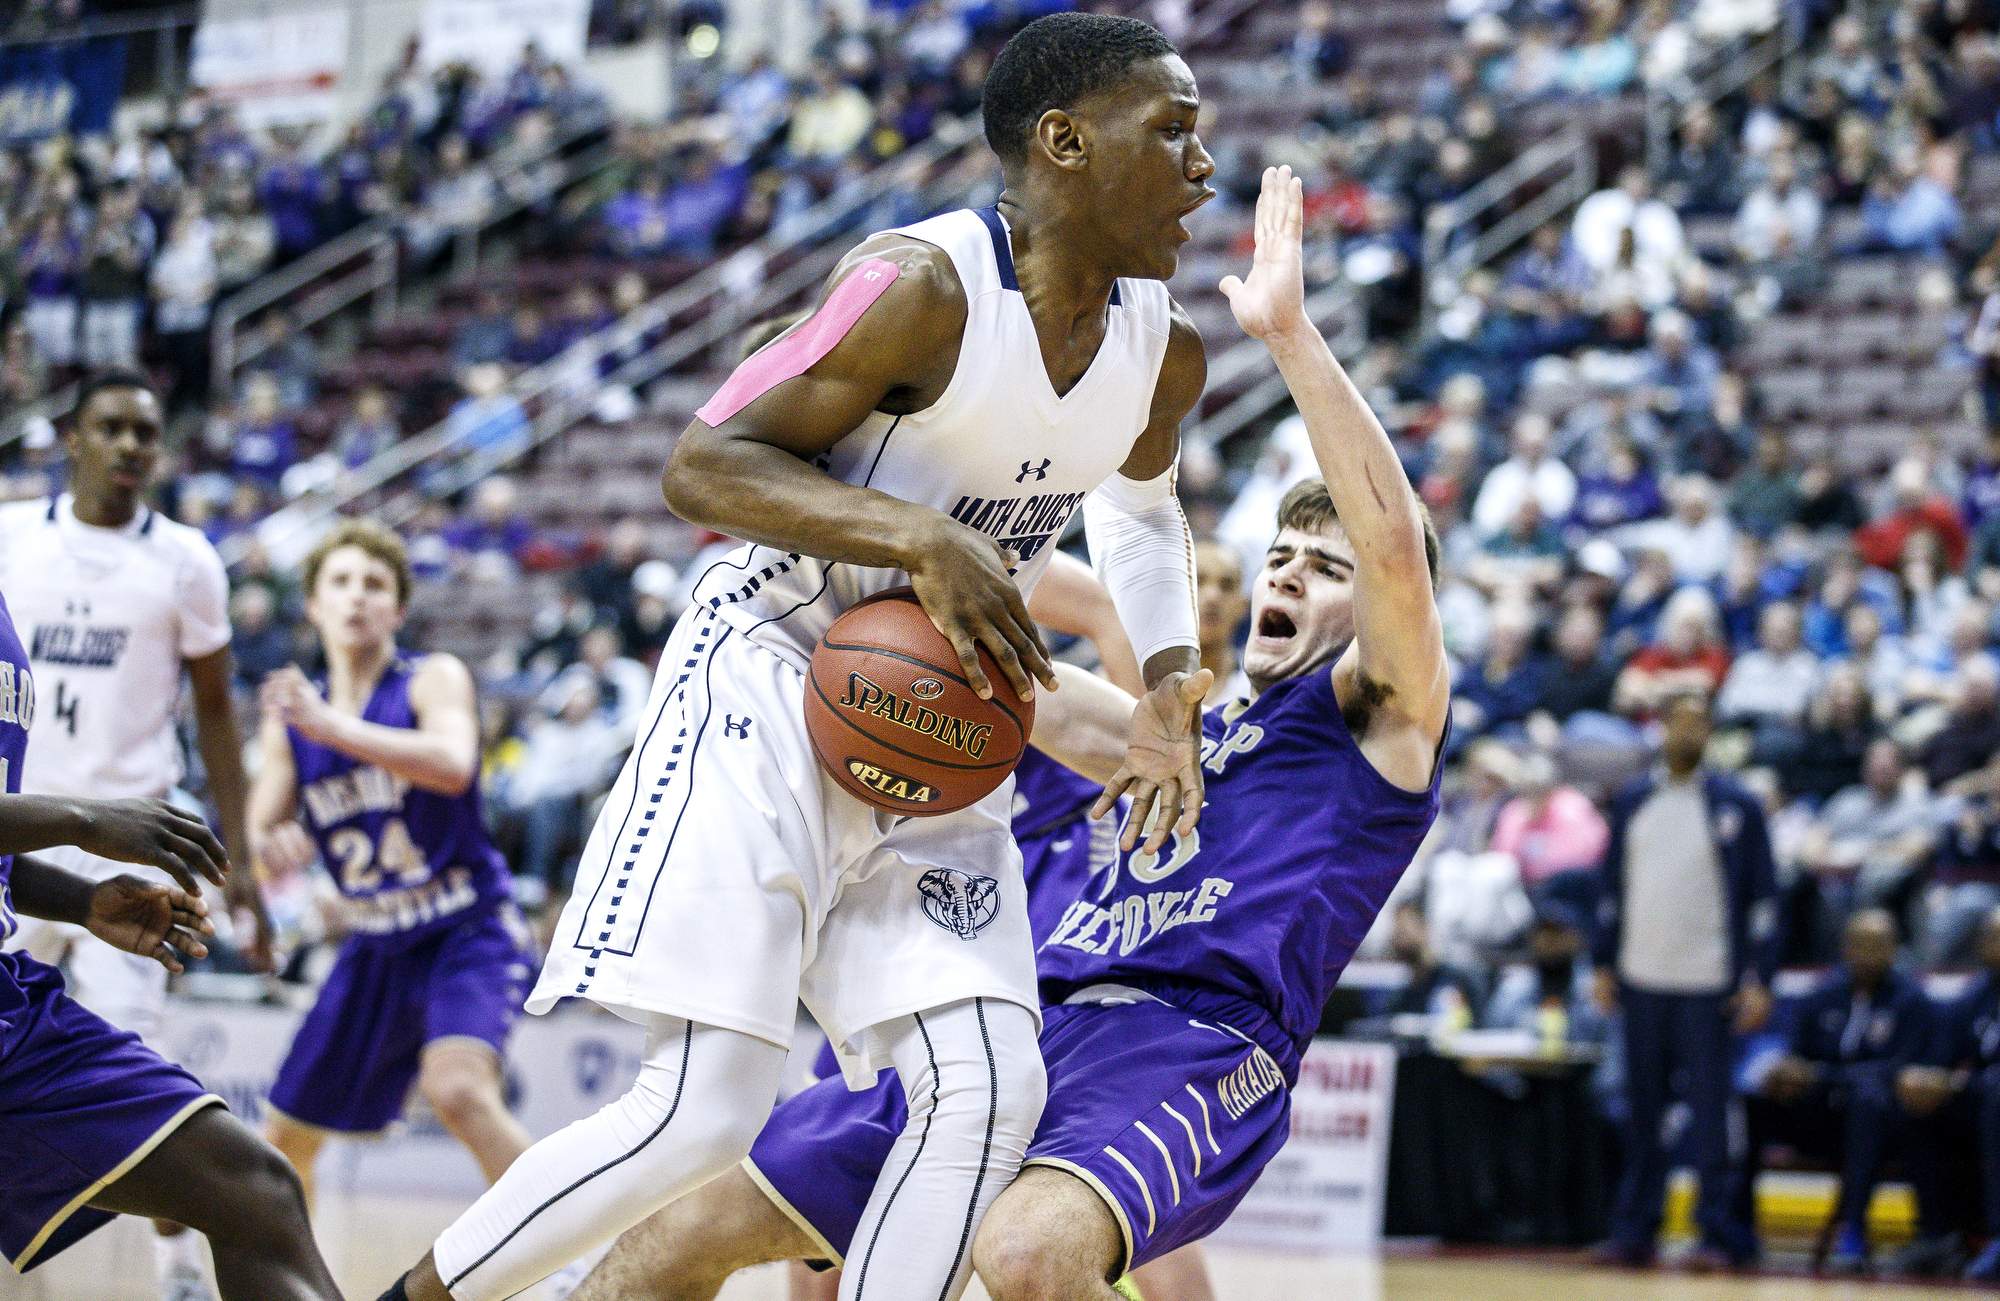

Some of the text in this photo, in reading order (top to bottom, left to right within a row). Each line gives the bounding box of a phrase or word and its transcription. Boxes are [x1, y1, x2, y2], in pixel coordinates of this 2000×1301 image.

[863, 269, 882, 282] KT
[55, 679, 79, 736] 4
[839, 670, 994, 760] SPALDING
[857, 763, 931, 802] PIAA
[328, 816, 433, 892] 24
